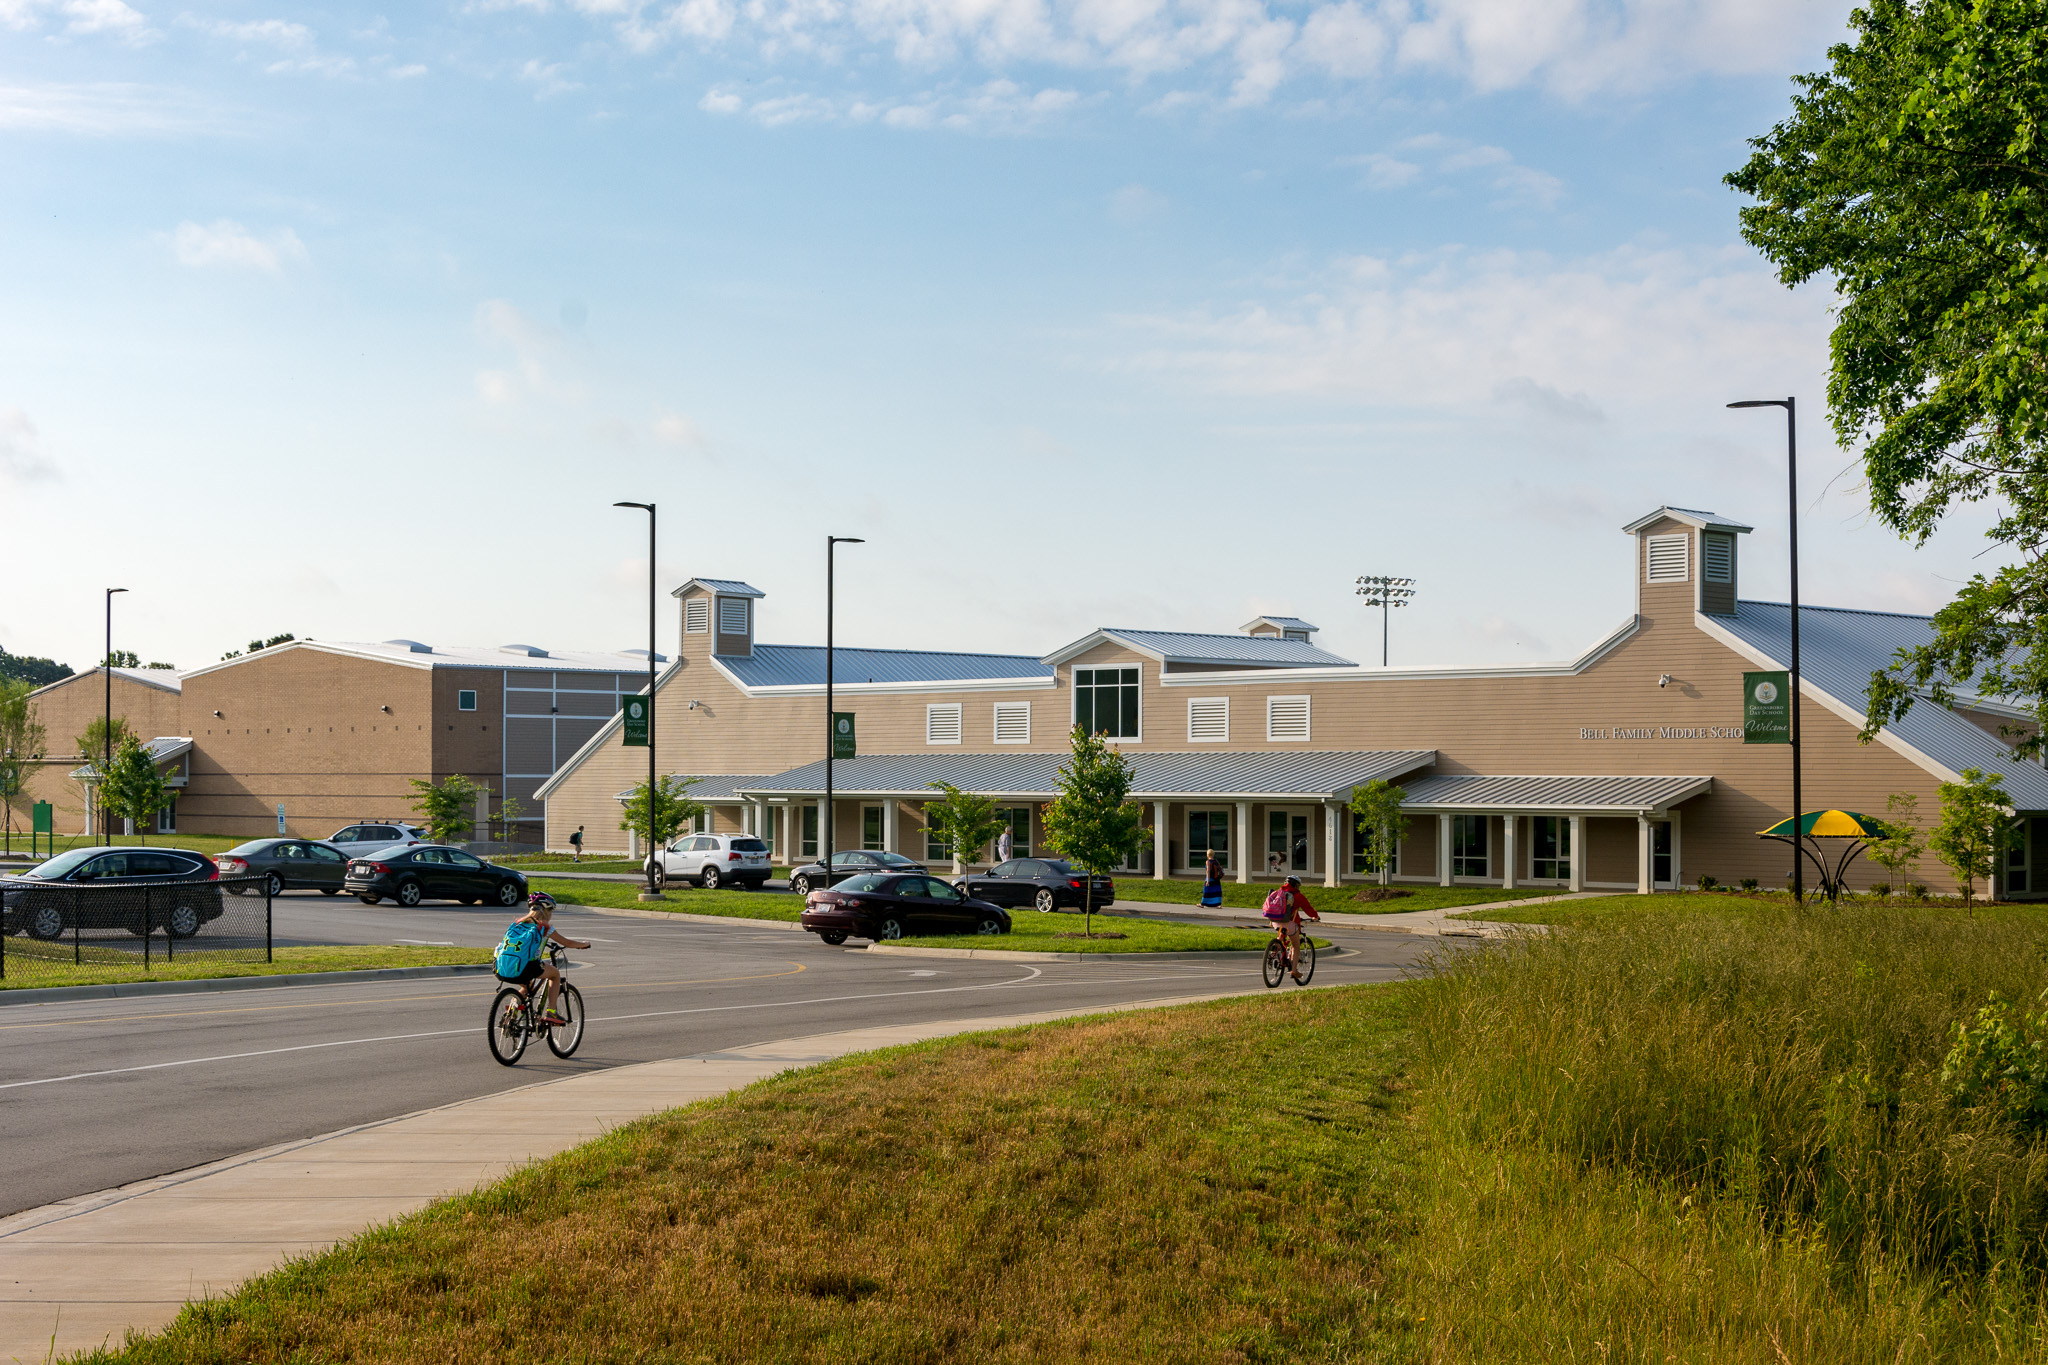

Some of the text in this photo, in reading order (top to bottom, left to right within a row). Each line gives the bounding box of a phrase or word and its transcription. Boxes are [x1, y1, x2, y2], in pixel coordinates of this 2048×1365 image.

[1745, 720, 1788, 731] Welcome
[1580, 726, 1744, 739] BELL FAMILY MIDDLE SCHO
